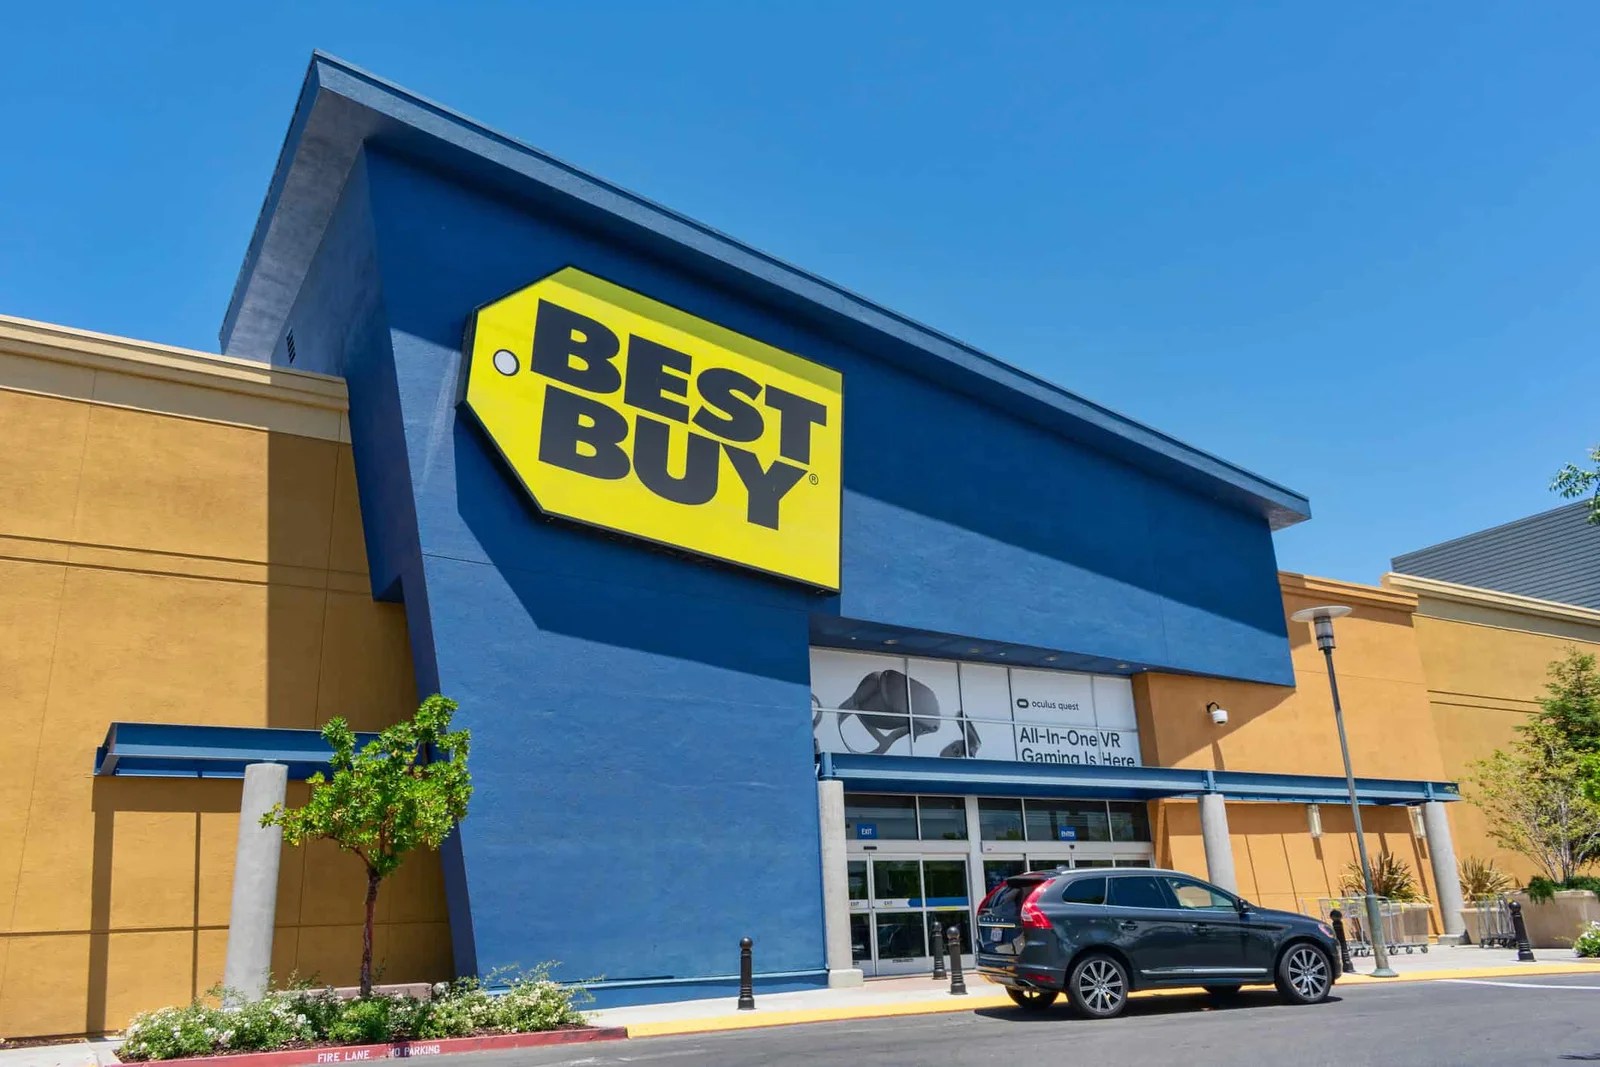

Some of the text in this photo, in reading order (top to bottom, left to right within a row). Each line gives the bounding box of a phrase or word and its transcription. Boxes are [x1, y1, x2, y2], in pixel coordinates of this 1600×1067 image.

[530, 298, 827, 466] BEST
[538, 384, 809, 531] BUY
[1032, 700, 1079, 711] oculus quest
[1020, 727, 1121, 748] All-In-One VR
[1084, 751, 1097, 765] Is
[1102, 752, 1135, 767] Here
[317, 1050, 370, 1063] FIRE LANE
[404, 1045, 440, 1056] PARKING
